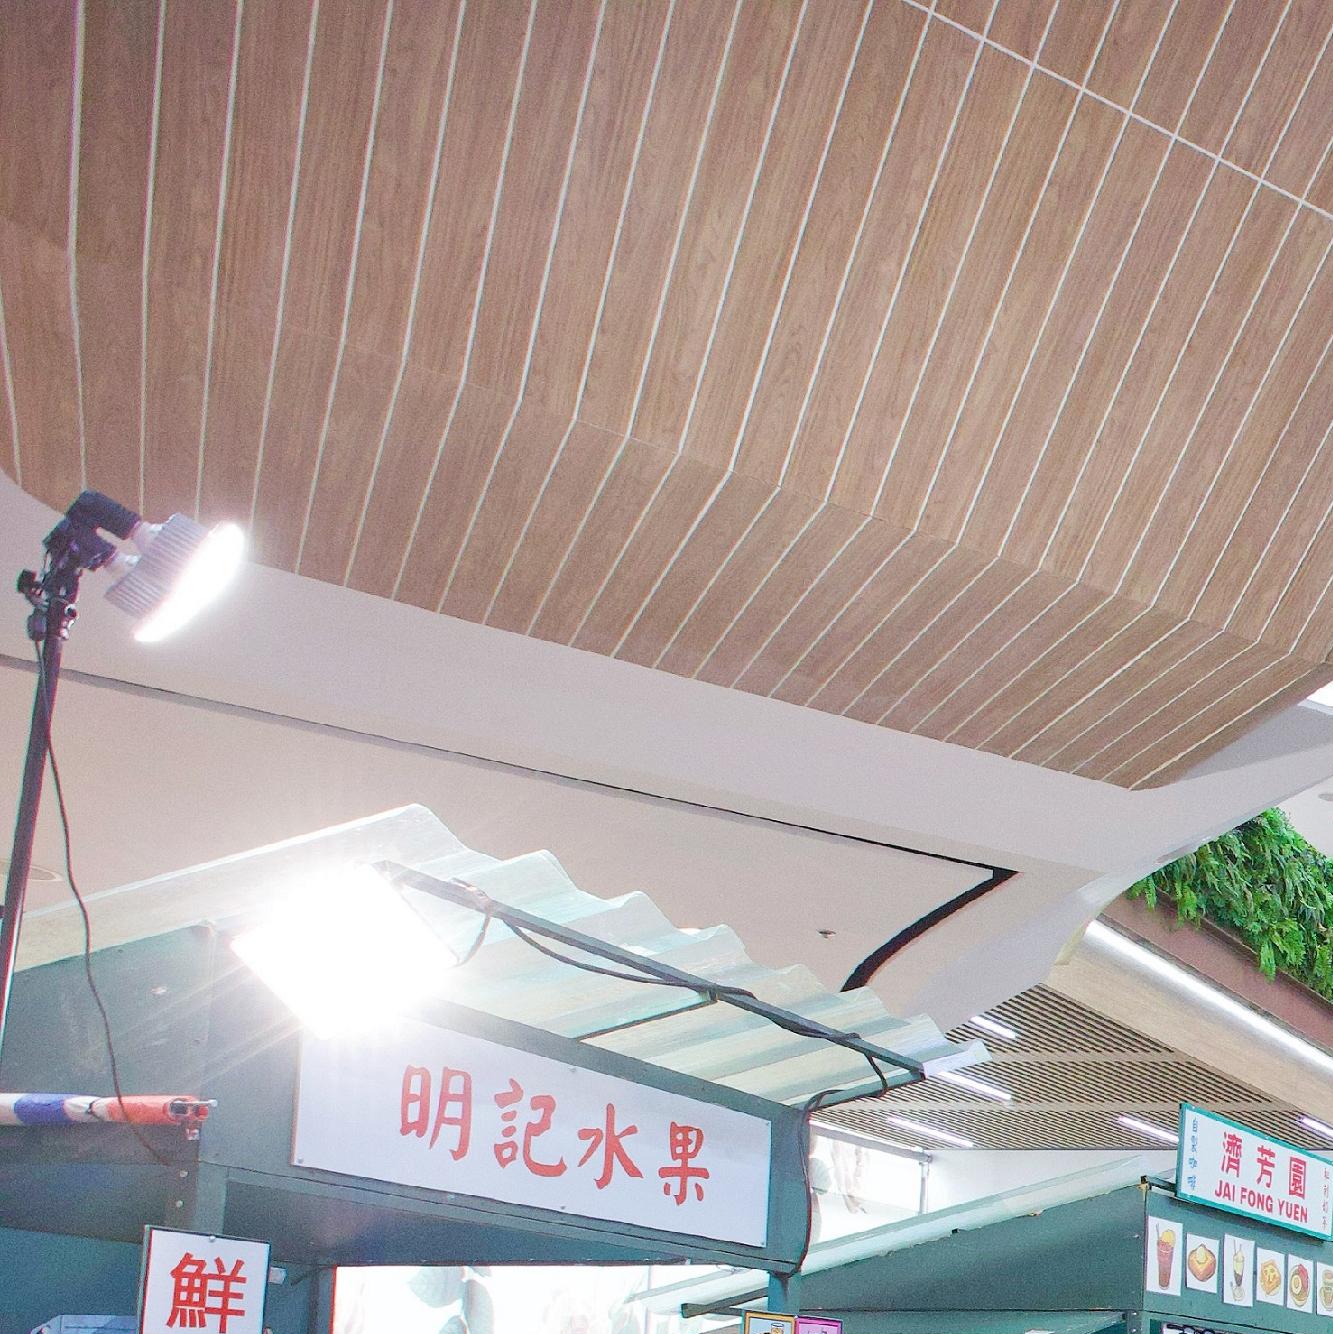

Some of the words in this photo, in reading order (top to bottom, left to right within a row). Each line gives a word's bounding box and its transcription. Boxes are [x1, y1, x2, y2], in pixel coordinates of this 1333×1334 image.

[400, 1063, 713, 1207] 明記水果
[1215, 1179, 1235, 1202] JAI
[1240, 1186, 1273, 1213] FONG
[1278, 1198, 1308, 1223] YUEN
